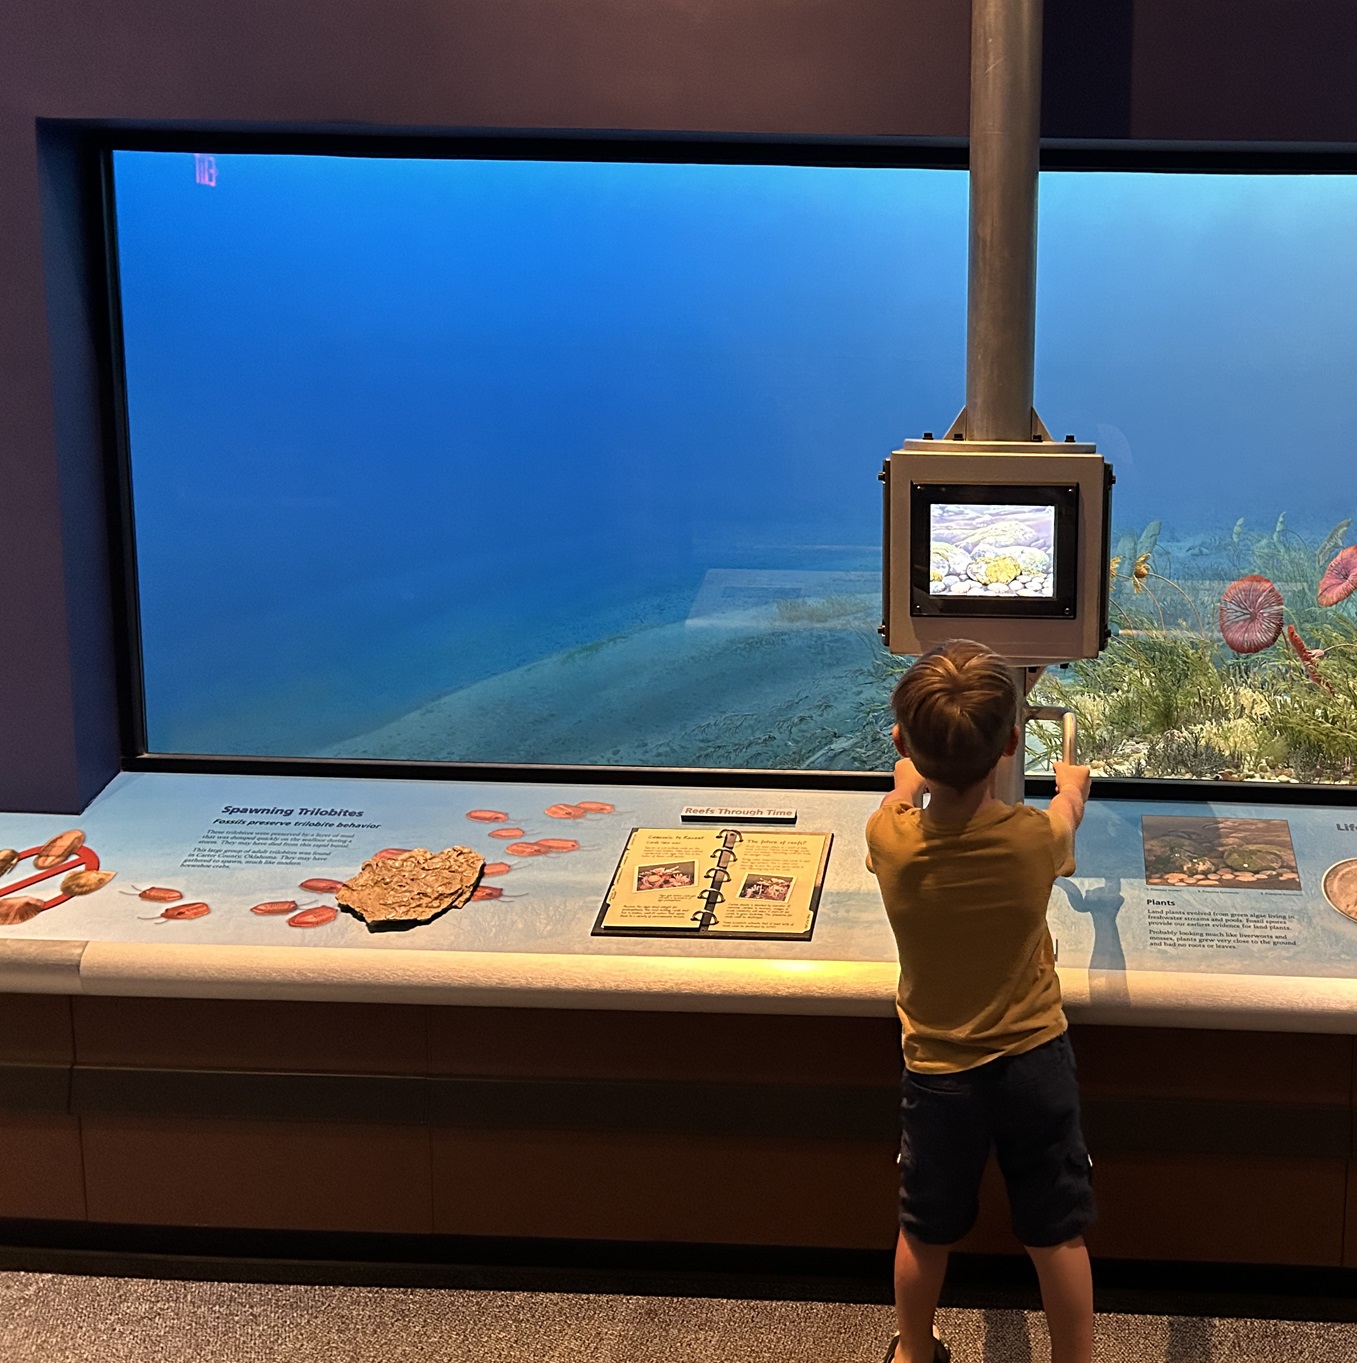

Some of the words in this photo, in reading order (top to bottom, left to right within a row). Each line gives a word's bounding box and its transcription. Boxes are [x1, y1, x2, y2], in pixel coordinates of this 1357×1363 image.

[222, 806, 294, 816] Spawning
[299, 808, 364, 817] Trilobites
[718, 808, 764, 816] Through
